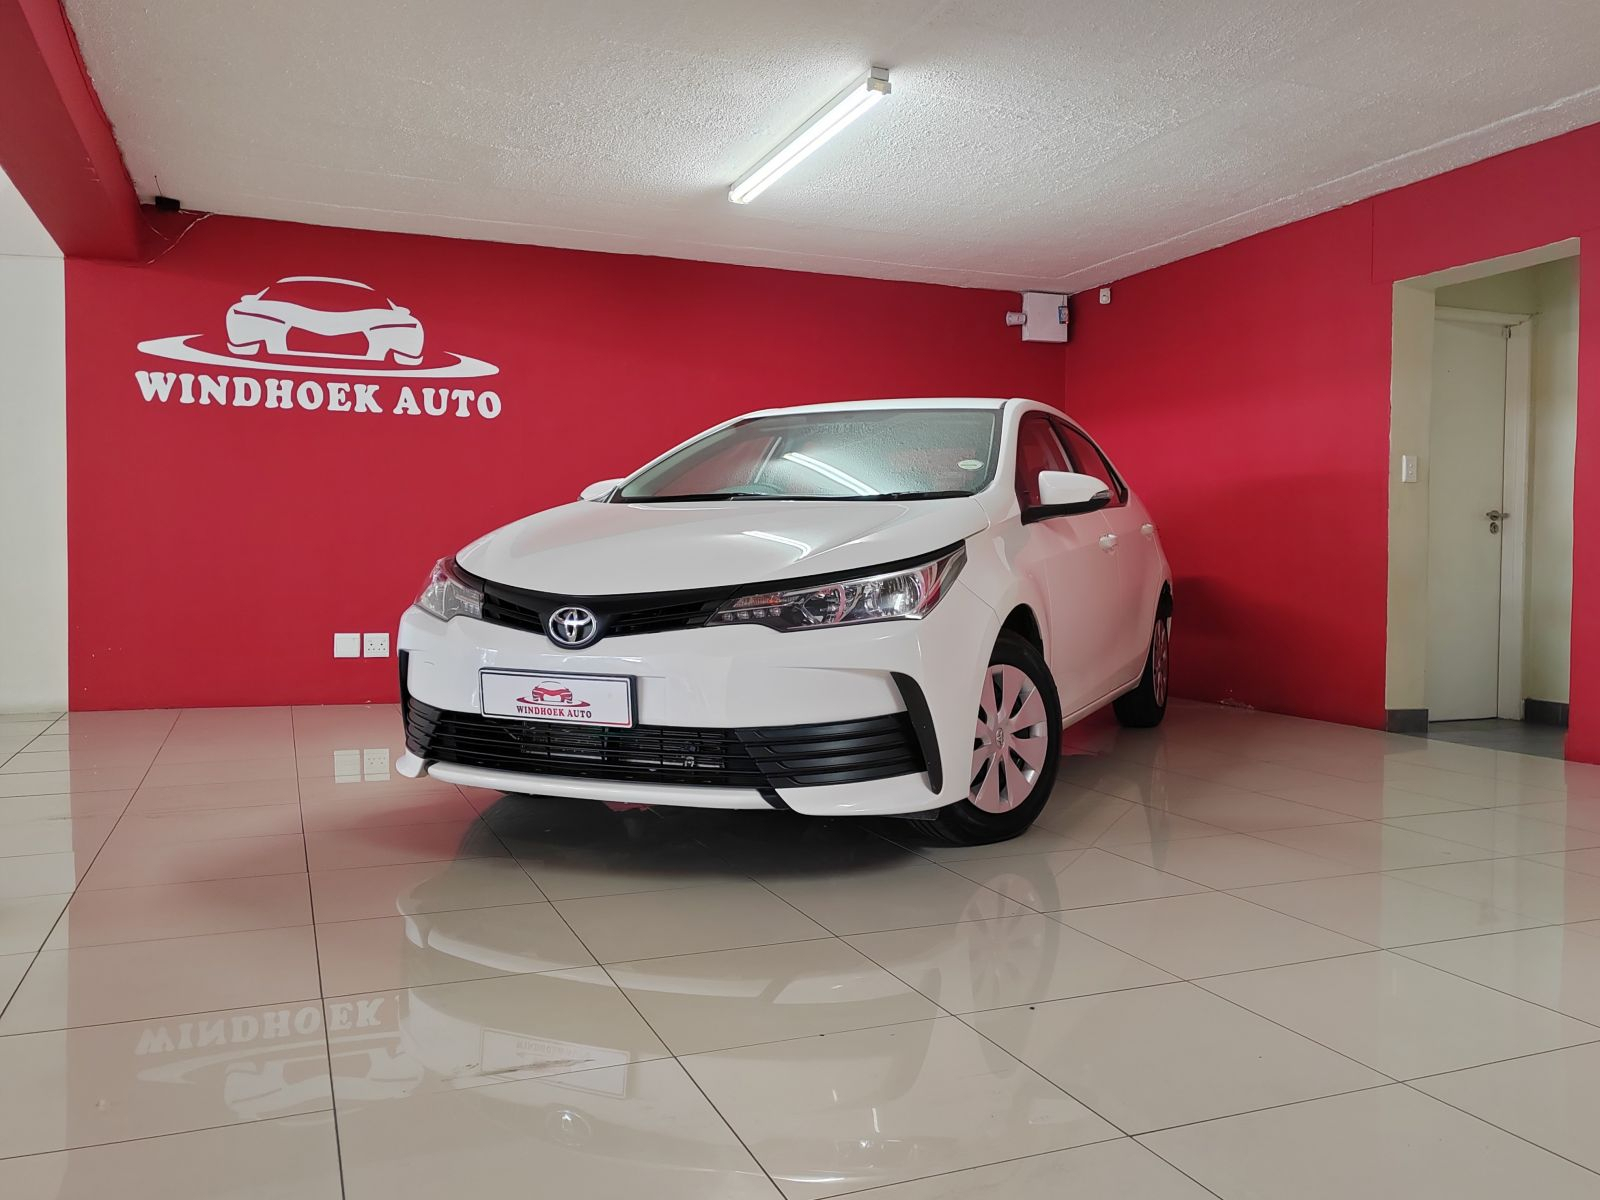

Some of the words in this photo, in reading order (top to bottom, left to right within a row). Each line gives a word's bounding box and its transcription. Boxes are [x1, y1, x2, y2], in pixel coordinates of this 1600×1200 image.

[135, 370, 383, 413] WINDHOEK
[393, 386, 502, 419] AUTO
[516, 705, 565, 717] WINDHOEK
[567, 709, 592, 719] AUTO
